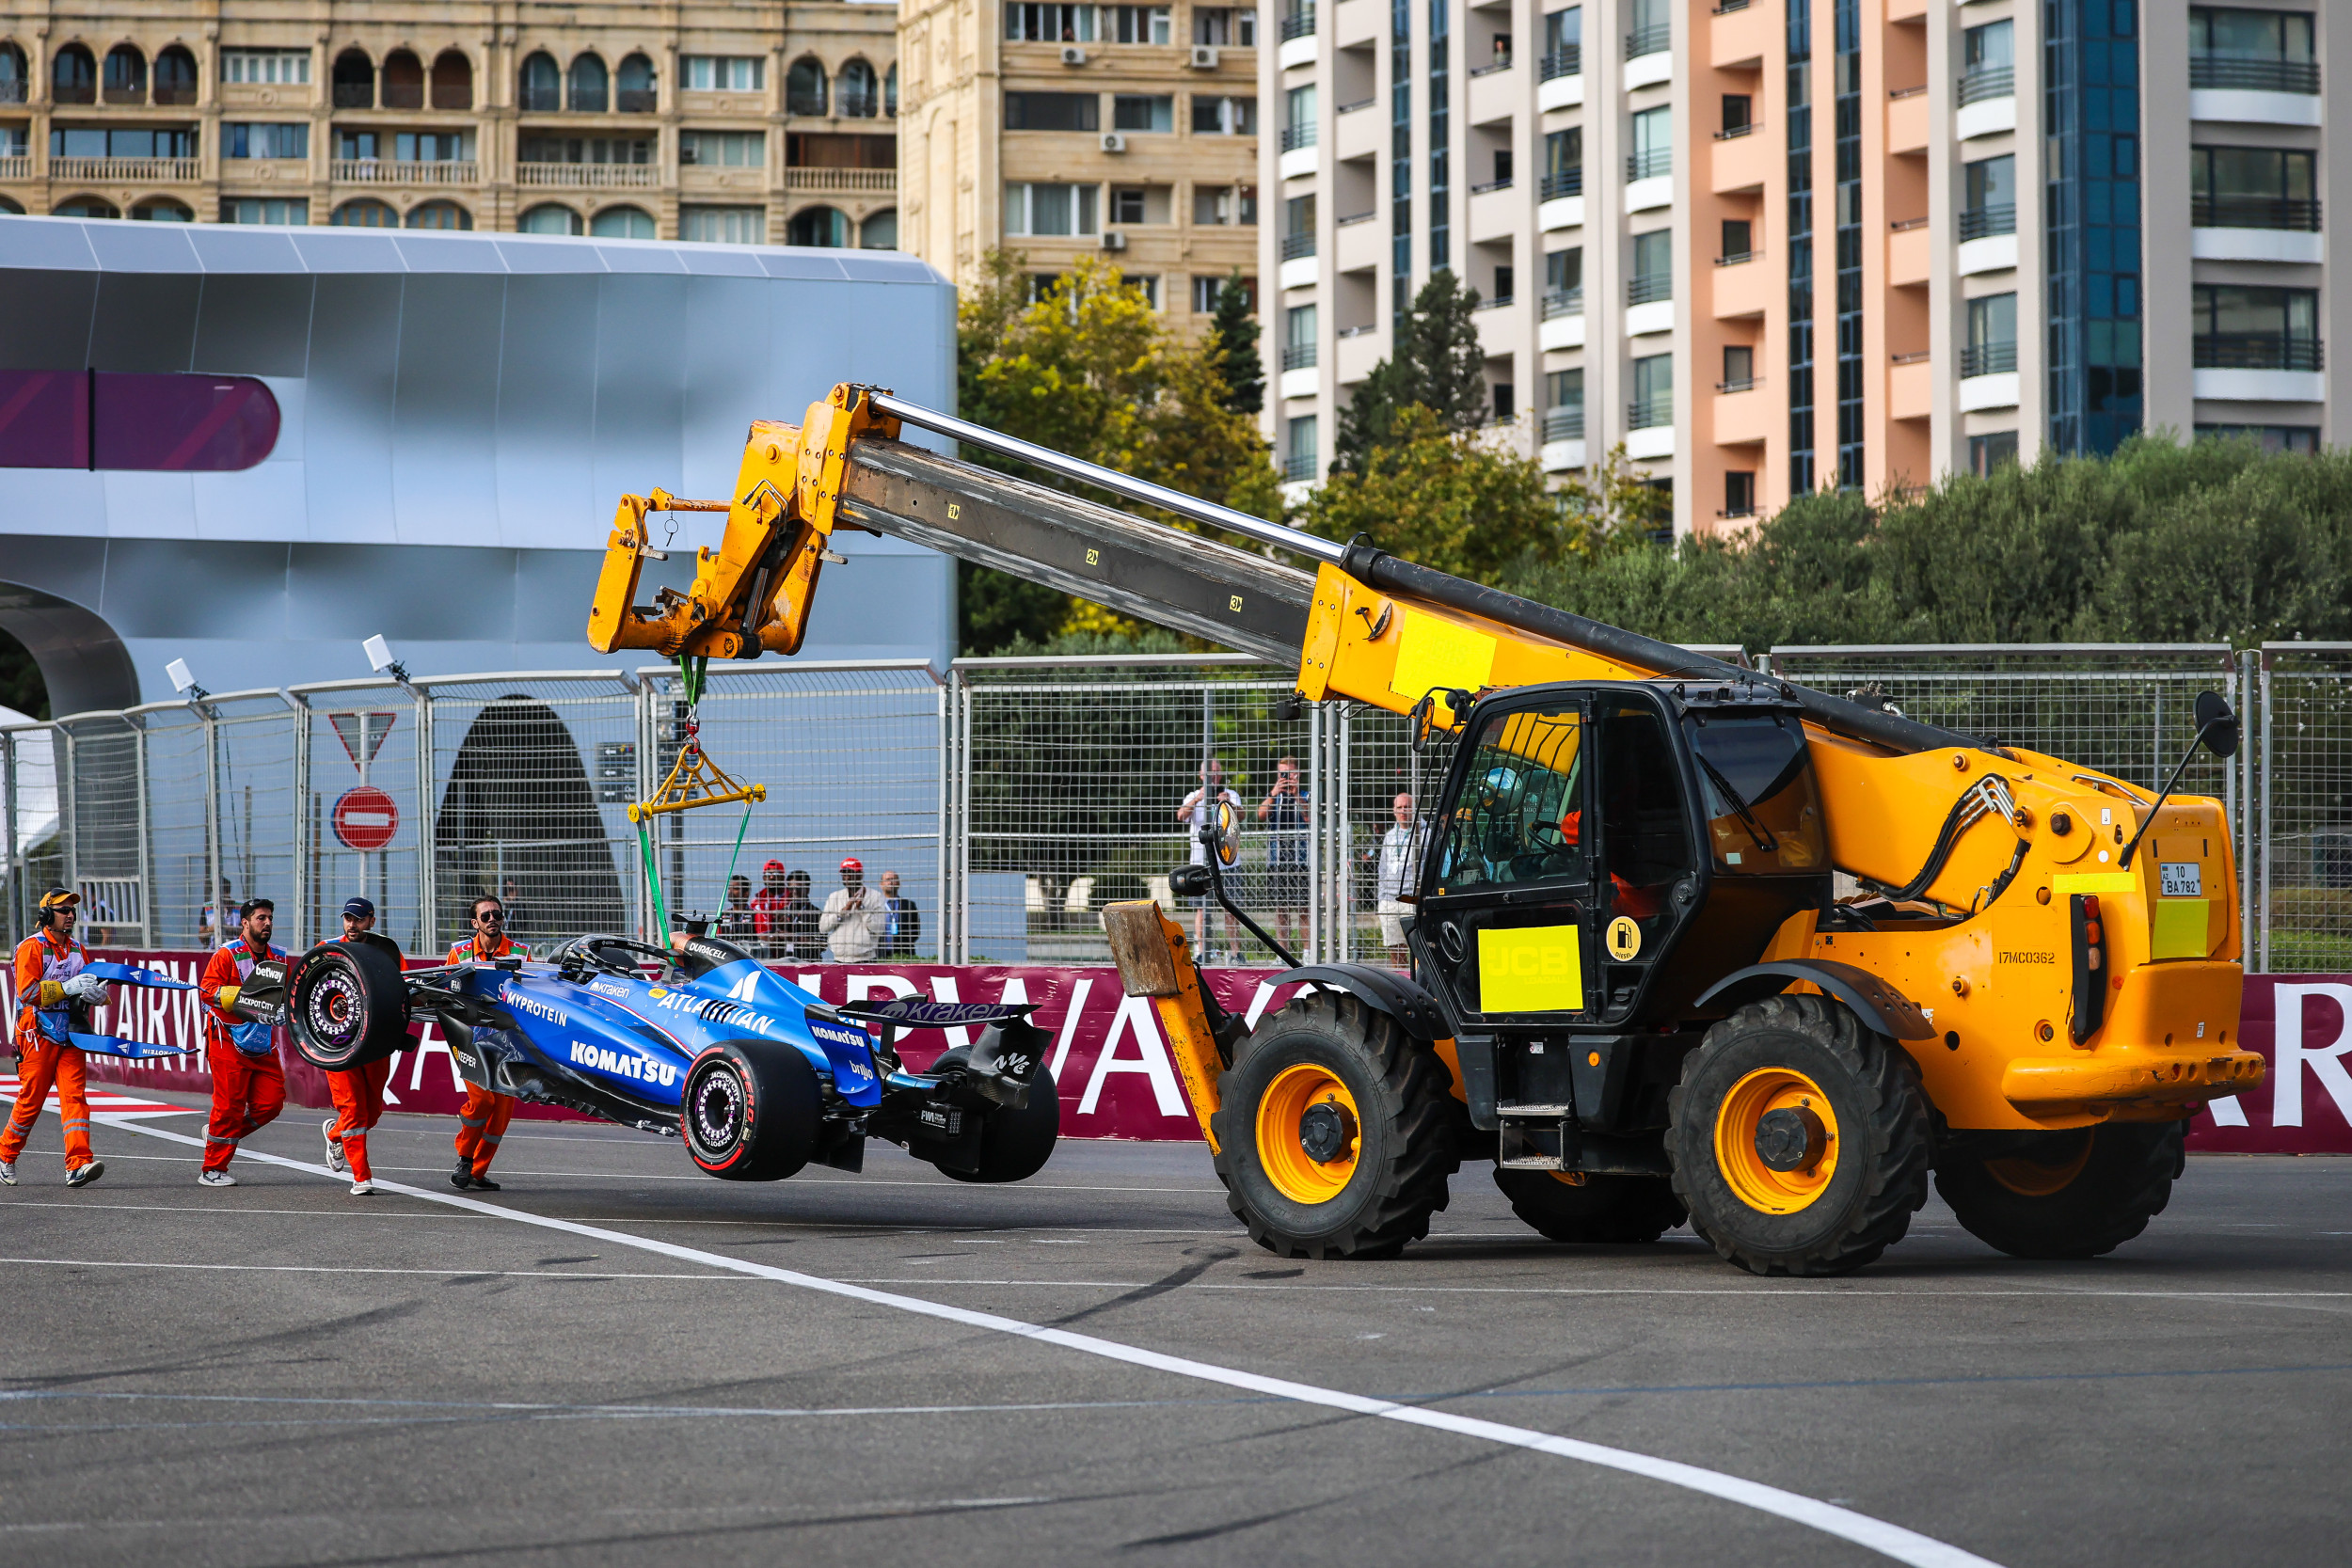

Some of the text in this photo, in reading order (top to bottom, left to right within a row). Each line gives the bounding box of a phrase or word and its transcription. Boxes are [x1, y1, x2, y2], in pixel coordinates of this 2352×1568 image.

[1087, 550, 1094, 562] 2
[1231, 597, 1237, 609] 3
[2175, 865, 2185, 879] 10
[2167, 880, 2196, 894] BA 782
[689, 942, 727, 960] DURACELL
[1614, 951, 1632, 959] DIESEL
[255, 964, 284, 983] betway
[238, 995, 275, 1011] JACKPOT CITY
[506, 990, 568, 1027] MYPROTEIN
[657, 992, 775, 1036] ATLASSIAN
[811, 1025, 866, 1048] KOMATSU
[457, 1050, 477, 1069] KEEPER
[569, 1040, 677, 1087] KOMATSU
[709, 1071, 740, 1103] JACKPOT CITY
[732, 1056, 742, 1068] P
[739, 1069, 755, 1124] ZERO
[710, 1131, 733, 1148] JACKPOT
